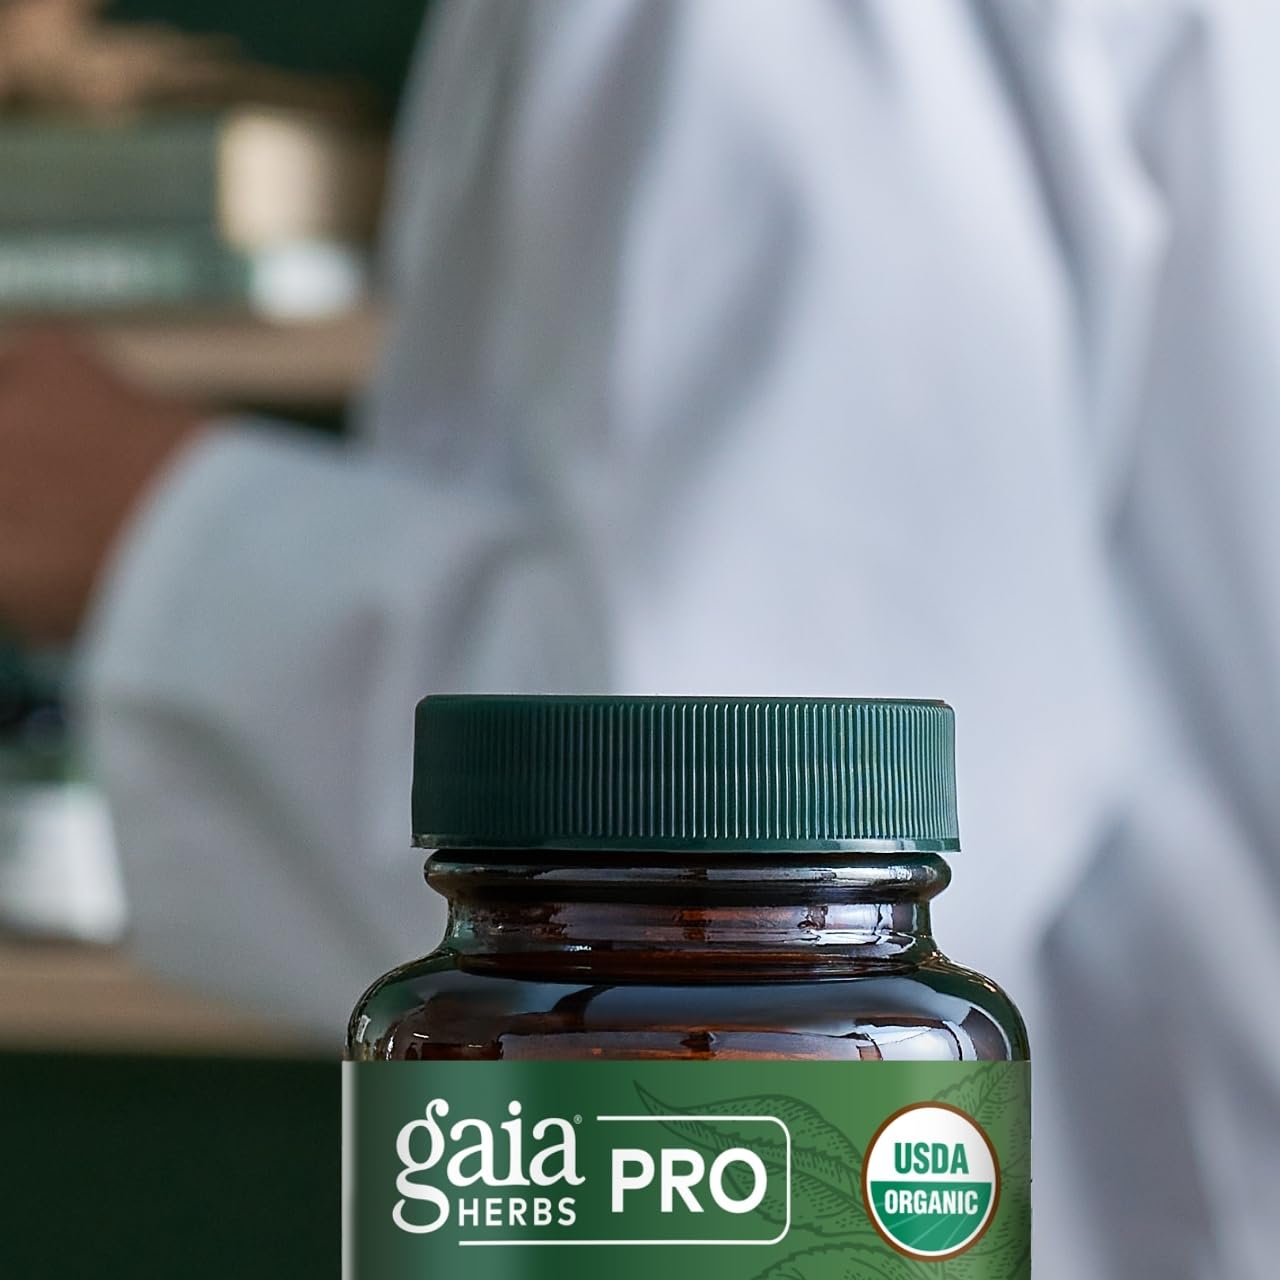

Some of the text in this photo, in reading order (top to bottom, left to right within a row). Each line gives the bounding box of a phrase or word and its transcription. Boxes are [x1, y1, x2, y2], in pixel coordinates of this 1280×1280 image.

[894, 1142, 969, 1174] USDA
[612, 1148, 767, 1213] PRO
[459, 1198, 576, 1226] HERBS
[884, 1190, 978, 1214] ORGANIC
